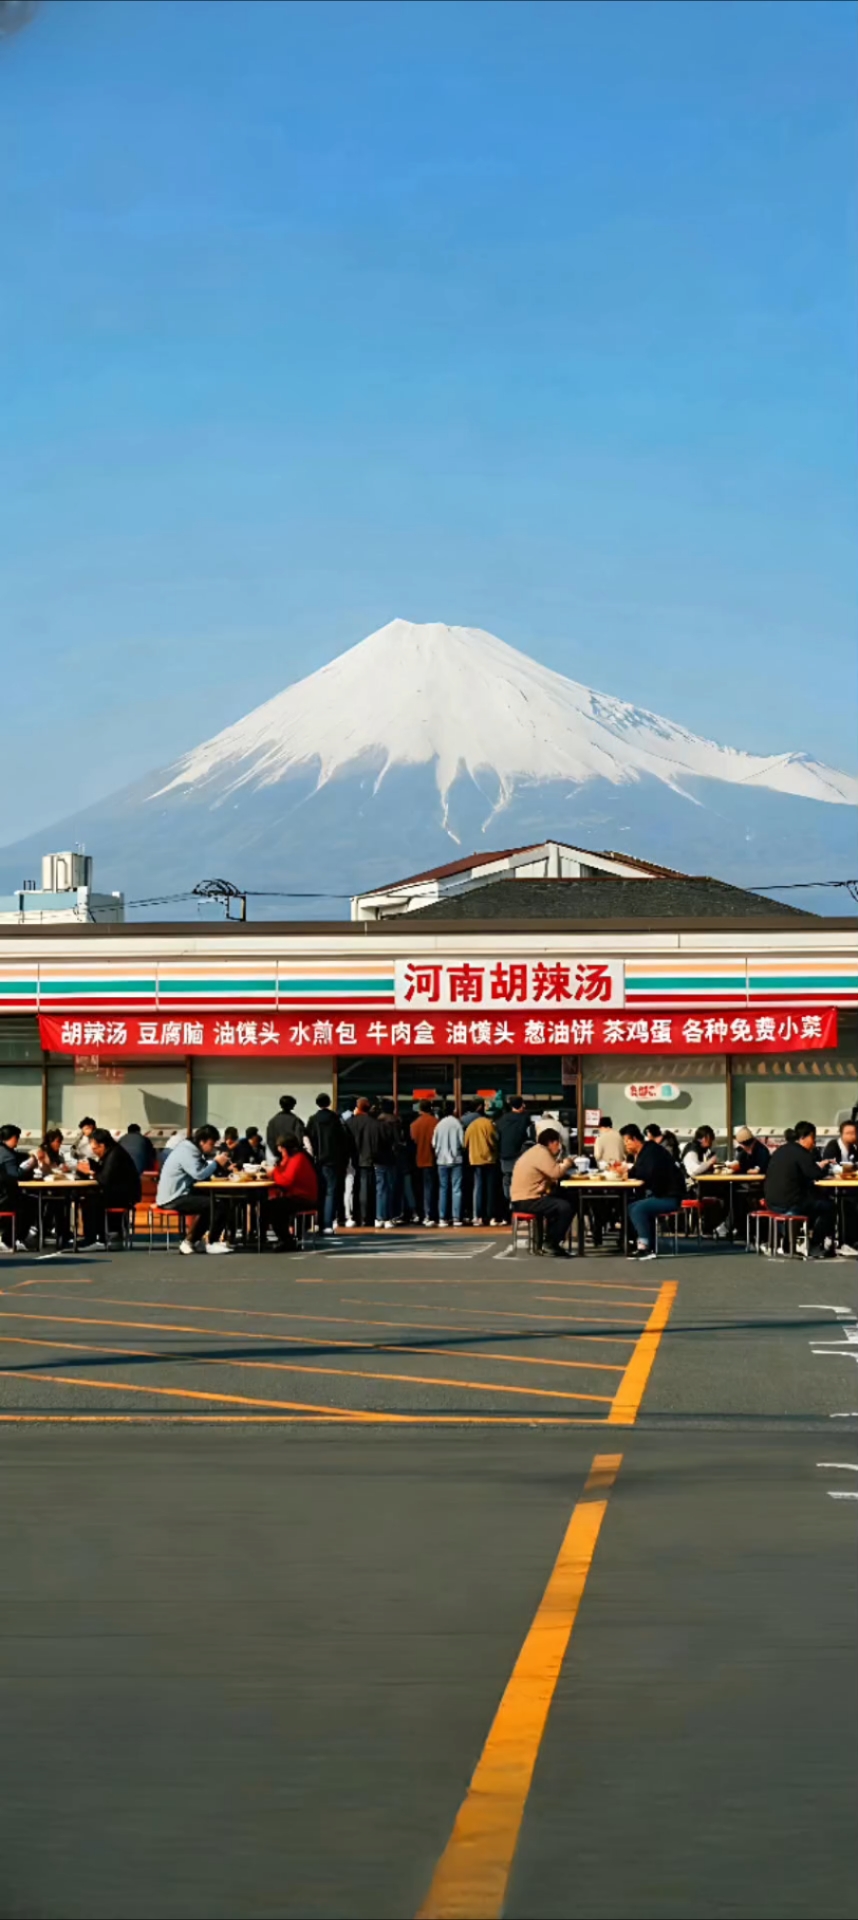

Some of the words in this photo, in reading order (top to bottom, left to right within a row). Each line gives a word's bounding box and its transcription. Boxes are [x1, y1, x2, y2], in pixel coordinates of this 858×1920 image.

[405, 963, 611, 1002] 河南胡辣汤
[62, 1022, 127, 1046] 胡辣汤
[214, 1021, 280, 1045] 油馍头
[290, 1020, 357, 1045] 水煎包
[367, 1020, 434, 1045] 牛肉盒
[446, 1020, 514, 1044] 油馍头
[525, 1020, 594, 1044] 葱油饼
[603, 1020, 671, 1043] 茶鸡蛋
[682, 1016, 821, 1042] 各种免费小菜
